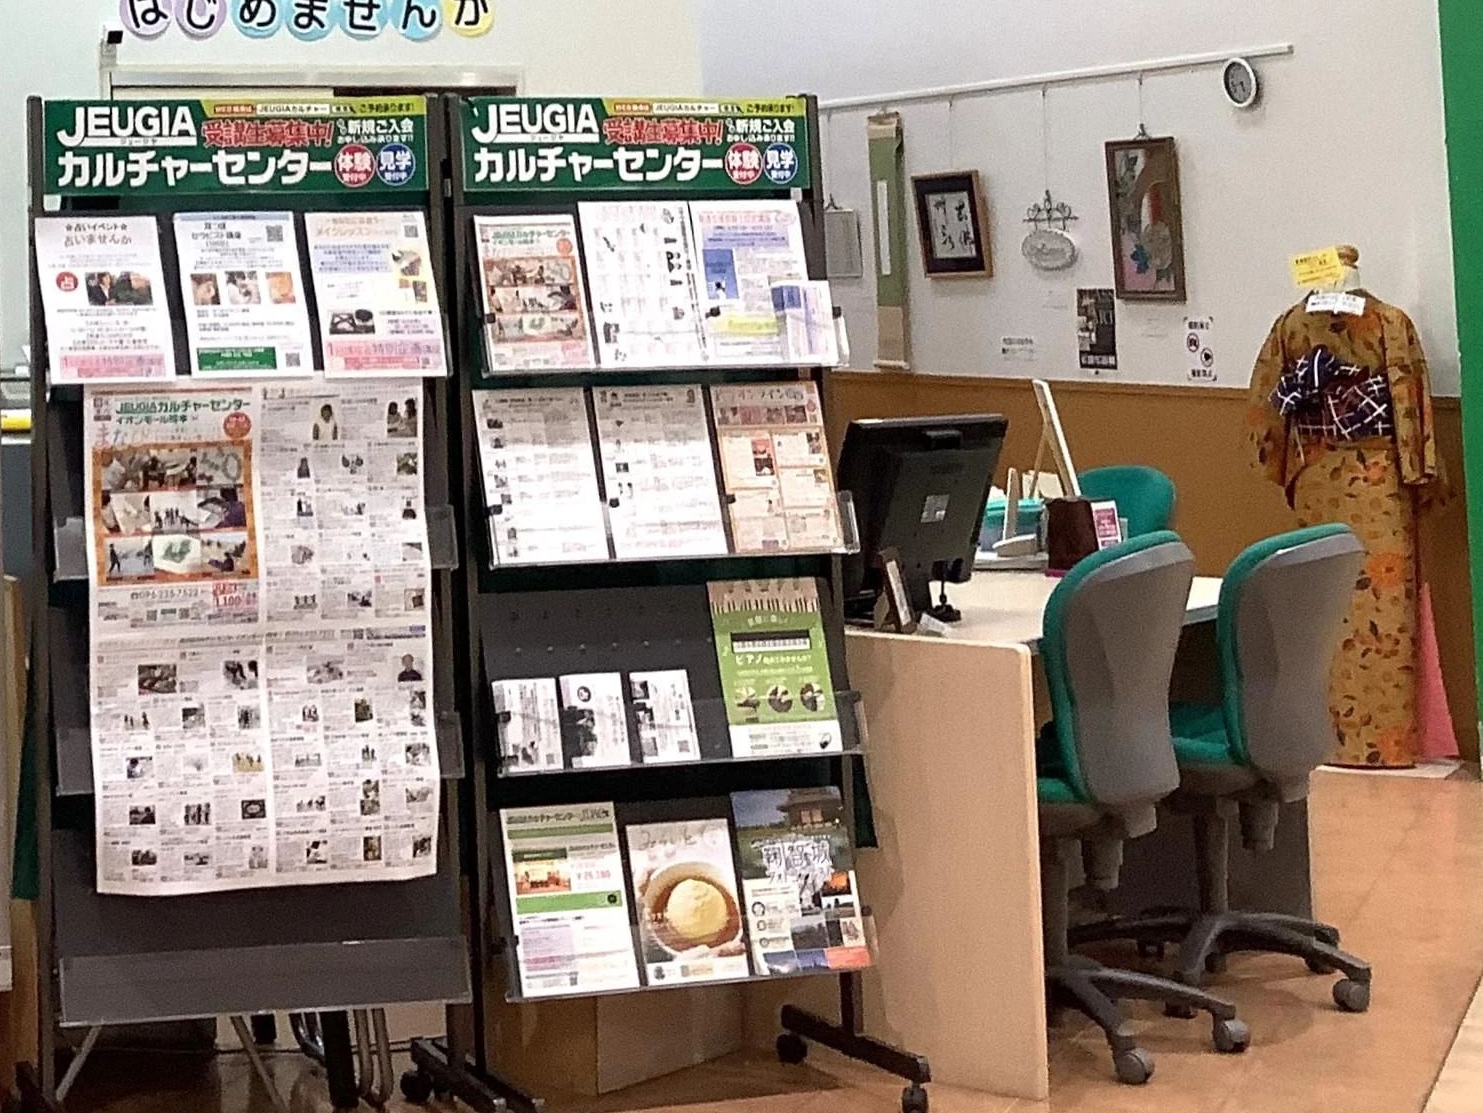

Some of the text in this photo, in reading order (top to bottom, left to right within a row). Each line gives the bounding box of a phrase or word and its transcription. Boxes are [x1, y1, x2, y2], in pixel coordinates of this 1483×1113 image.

[56, 106, 197, 147] JEUGIA
[202, 118, 334, 148] 受講生募集中!
[471, 103, 600, 143] JEUGIA
[603, 117, 724, 146] 受講生募集中!
[57, 149, 332, 187] カルチャーセンター
[338, 151, 372, 172] 体験
[379, 150, 412, 171] 見学
[473, 146, 724, 183] カルチャーセンター
[728, 149, 760, 170] 体験
[766, 149, 795, 170] 見学
